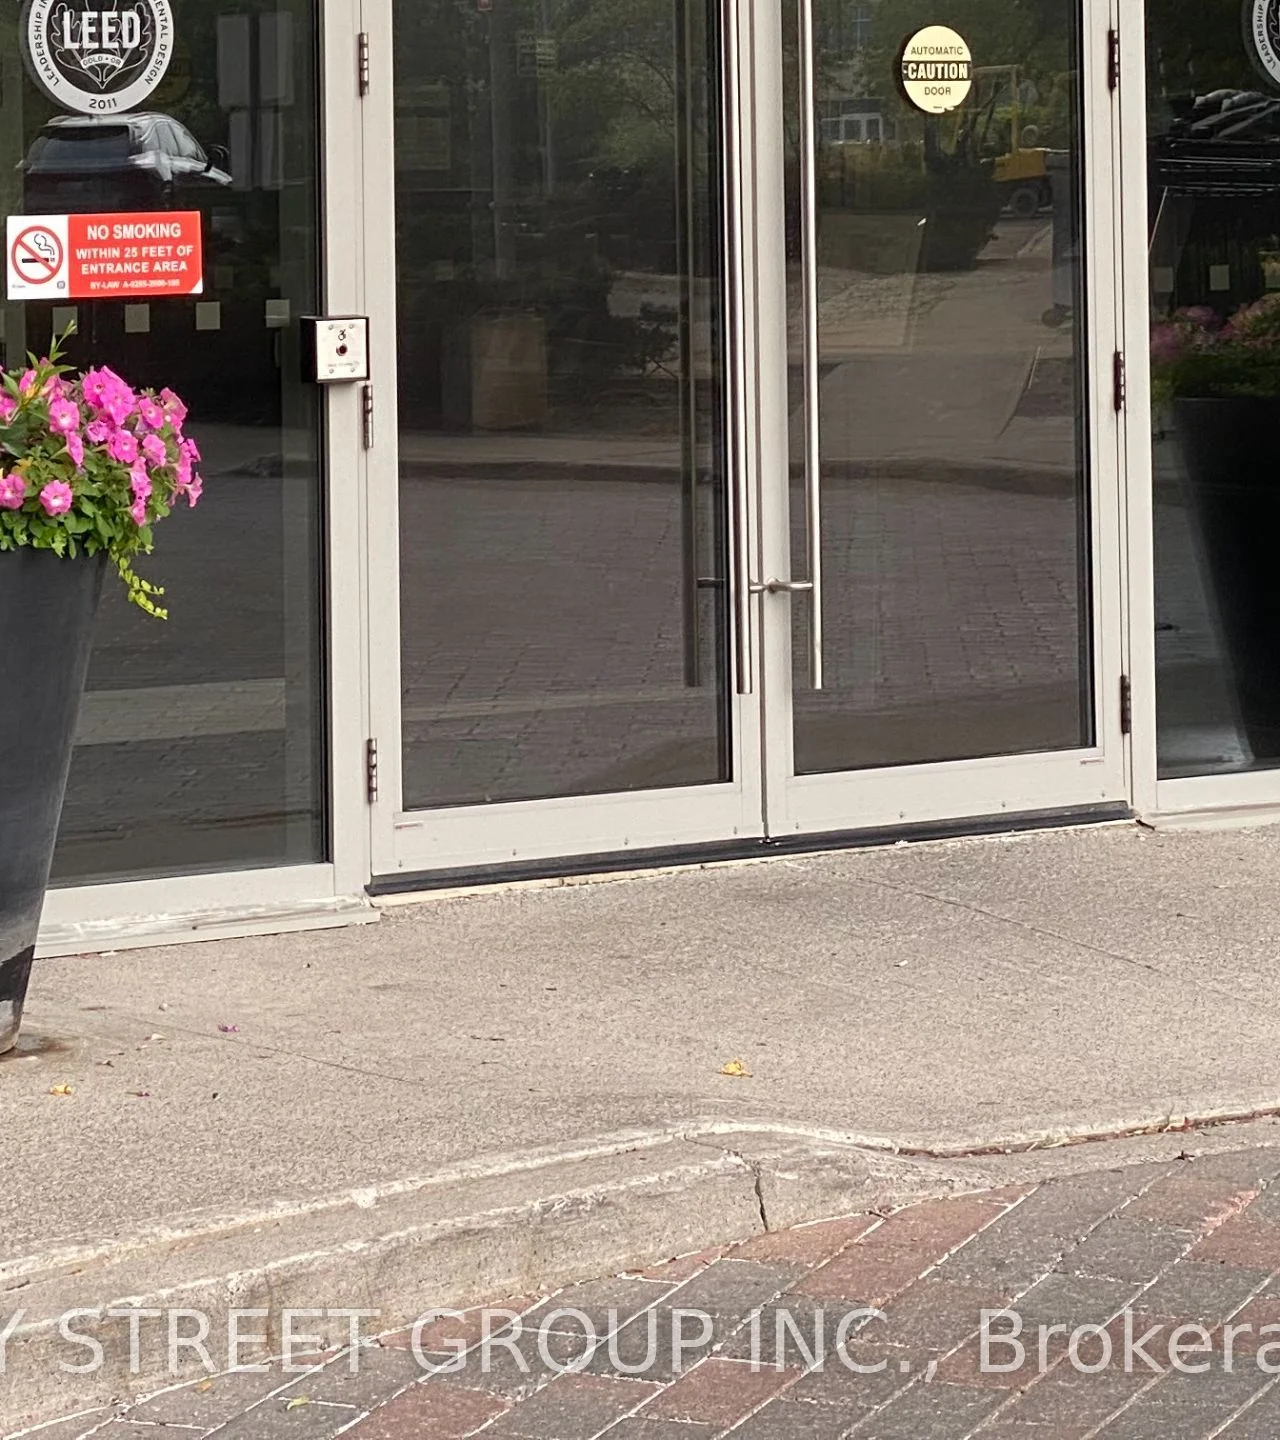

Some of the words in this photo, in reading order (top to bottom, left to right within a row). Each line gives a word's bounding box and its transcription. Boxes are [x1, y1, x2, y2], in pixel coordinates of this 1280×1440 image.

[62, 11, 141, 49] LEED
[1256, 4, 1276, 69] LEADERSHIP
[34, 12, 60, 86] LEADERSHIP
[145, 44, 167, 84] DESIGN
[910, 46, 964, 55] AUTOMATIC
[82, 55, 103, 66] GOLD
[907, 62, 968, 79] CAUTION
[924, 86, 952, 96] DOOR
[88, 97, 117, 109] 2011
[87, 225, 109, 240] NO
[113, 223, 181, 239] SMOKING
[75, 247, 120, 259] WITHIN
[123, 246, 138, 258] 25
[141, 245, 173, 257] FEET
[176, 244, 194, 256] OF
[81, 261, 149, 275] ENTRANCE
[153, 260, 188, 273] AREA
